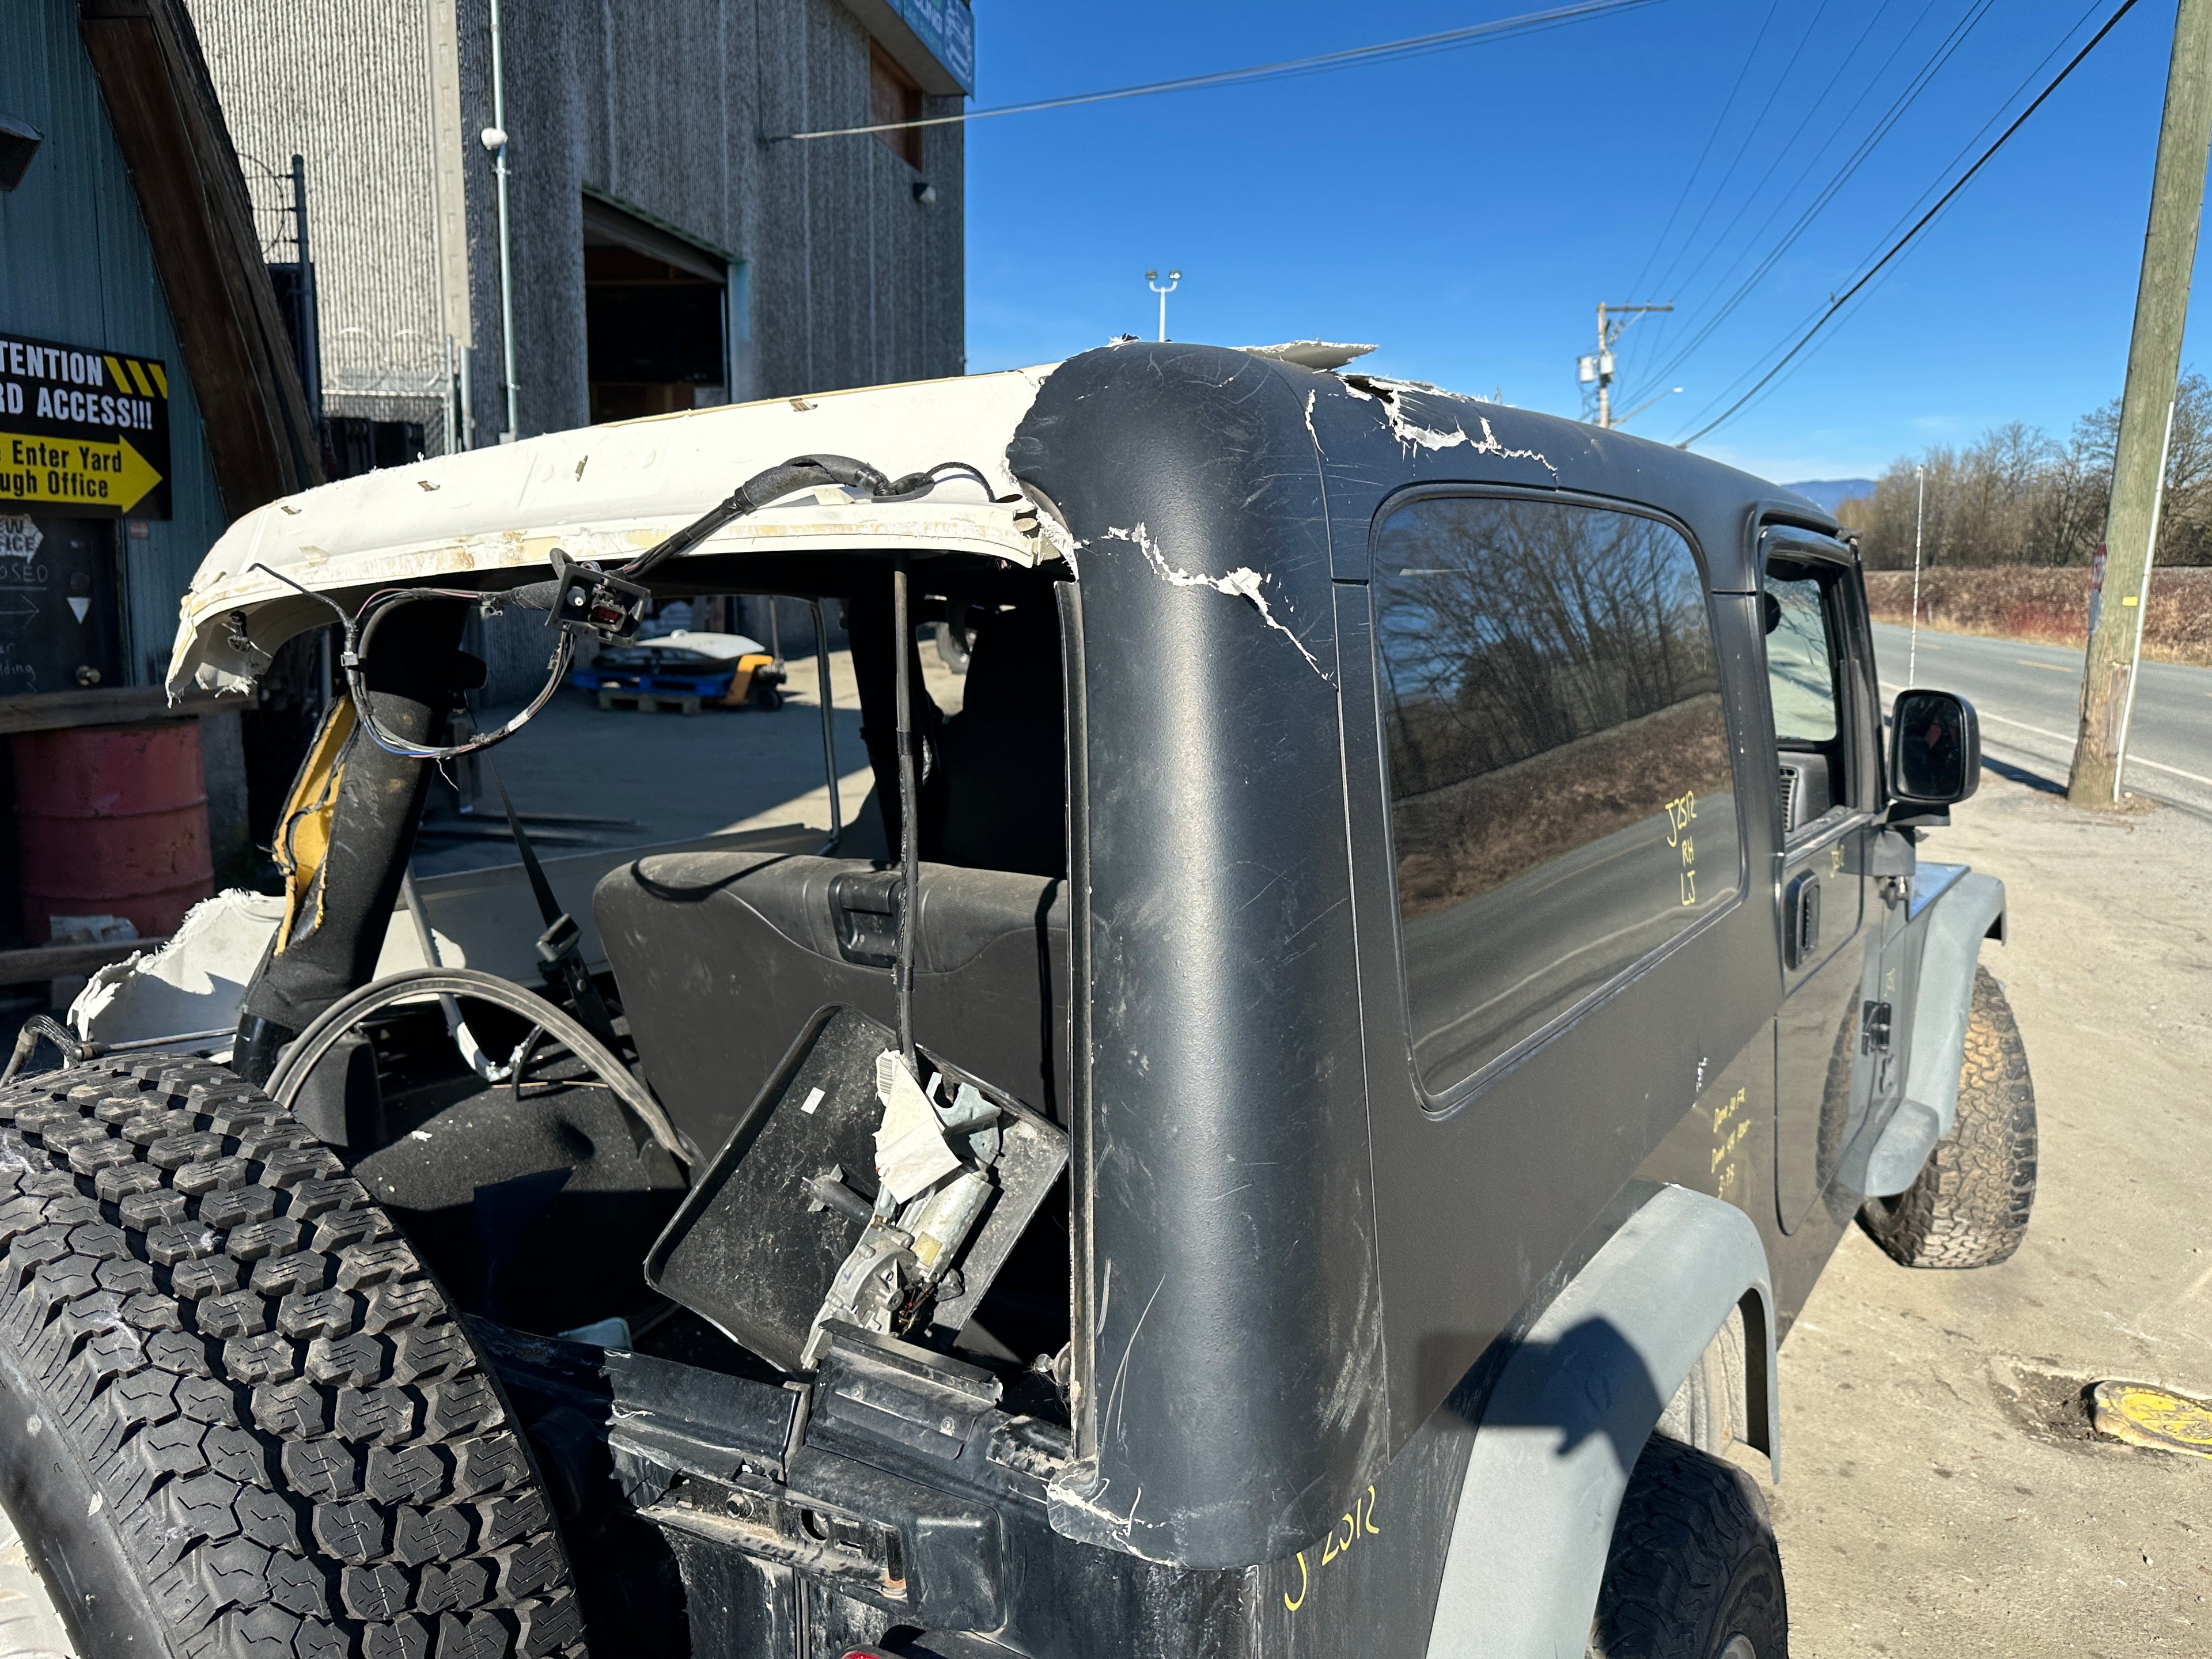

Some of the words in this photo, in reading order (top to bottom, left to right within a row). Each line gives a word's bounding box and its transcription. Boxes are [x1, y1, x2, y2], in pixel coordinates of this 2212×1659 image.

[37, 387, 153, 430] ACCESS!!!
[12, 440, 69, 468] Enter
[79, 446, 122, 474] Yard
[47, 470, 108, 498] Office
[1665, 790, 1697, 847] J2512
[1681, 836, 1695, 868] RH
